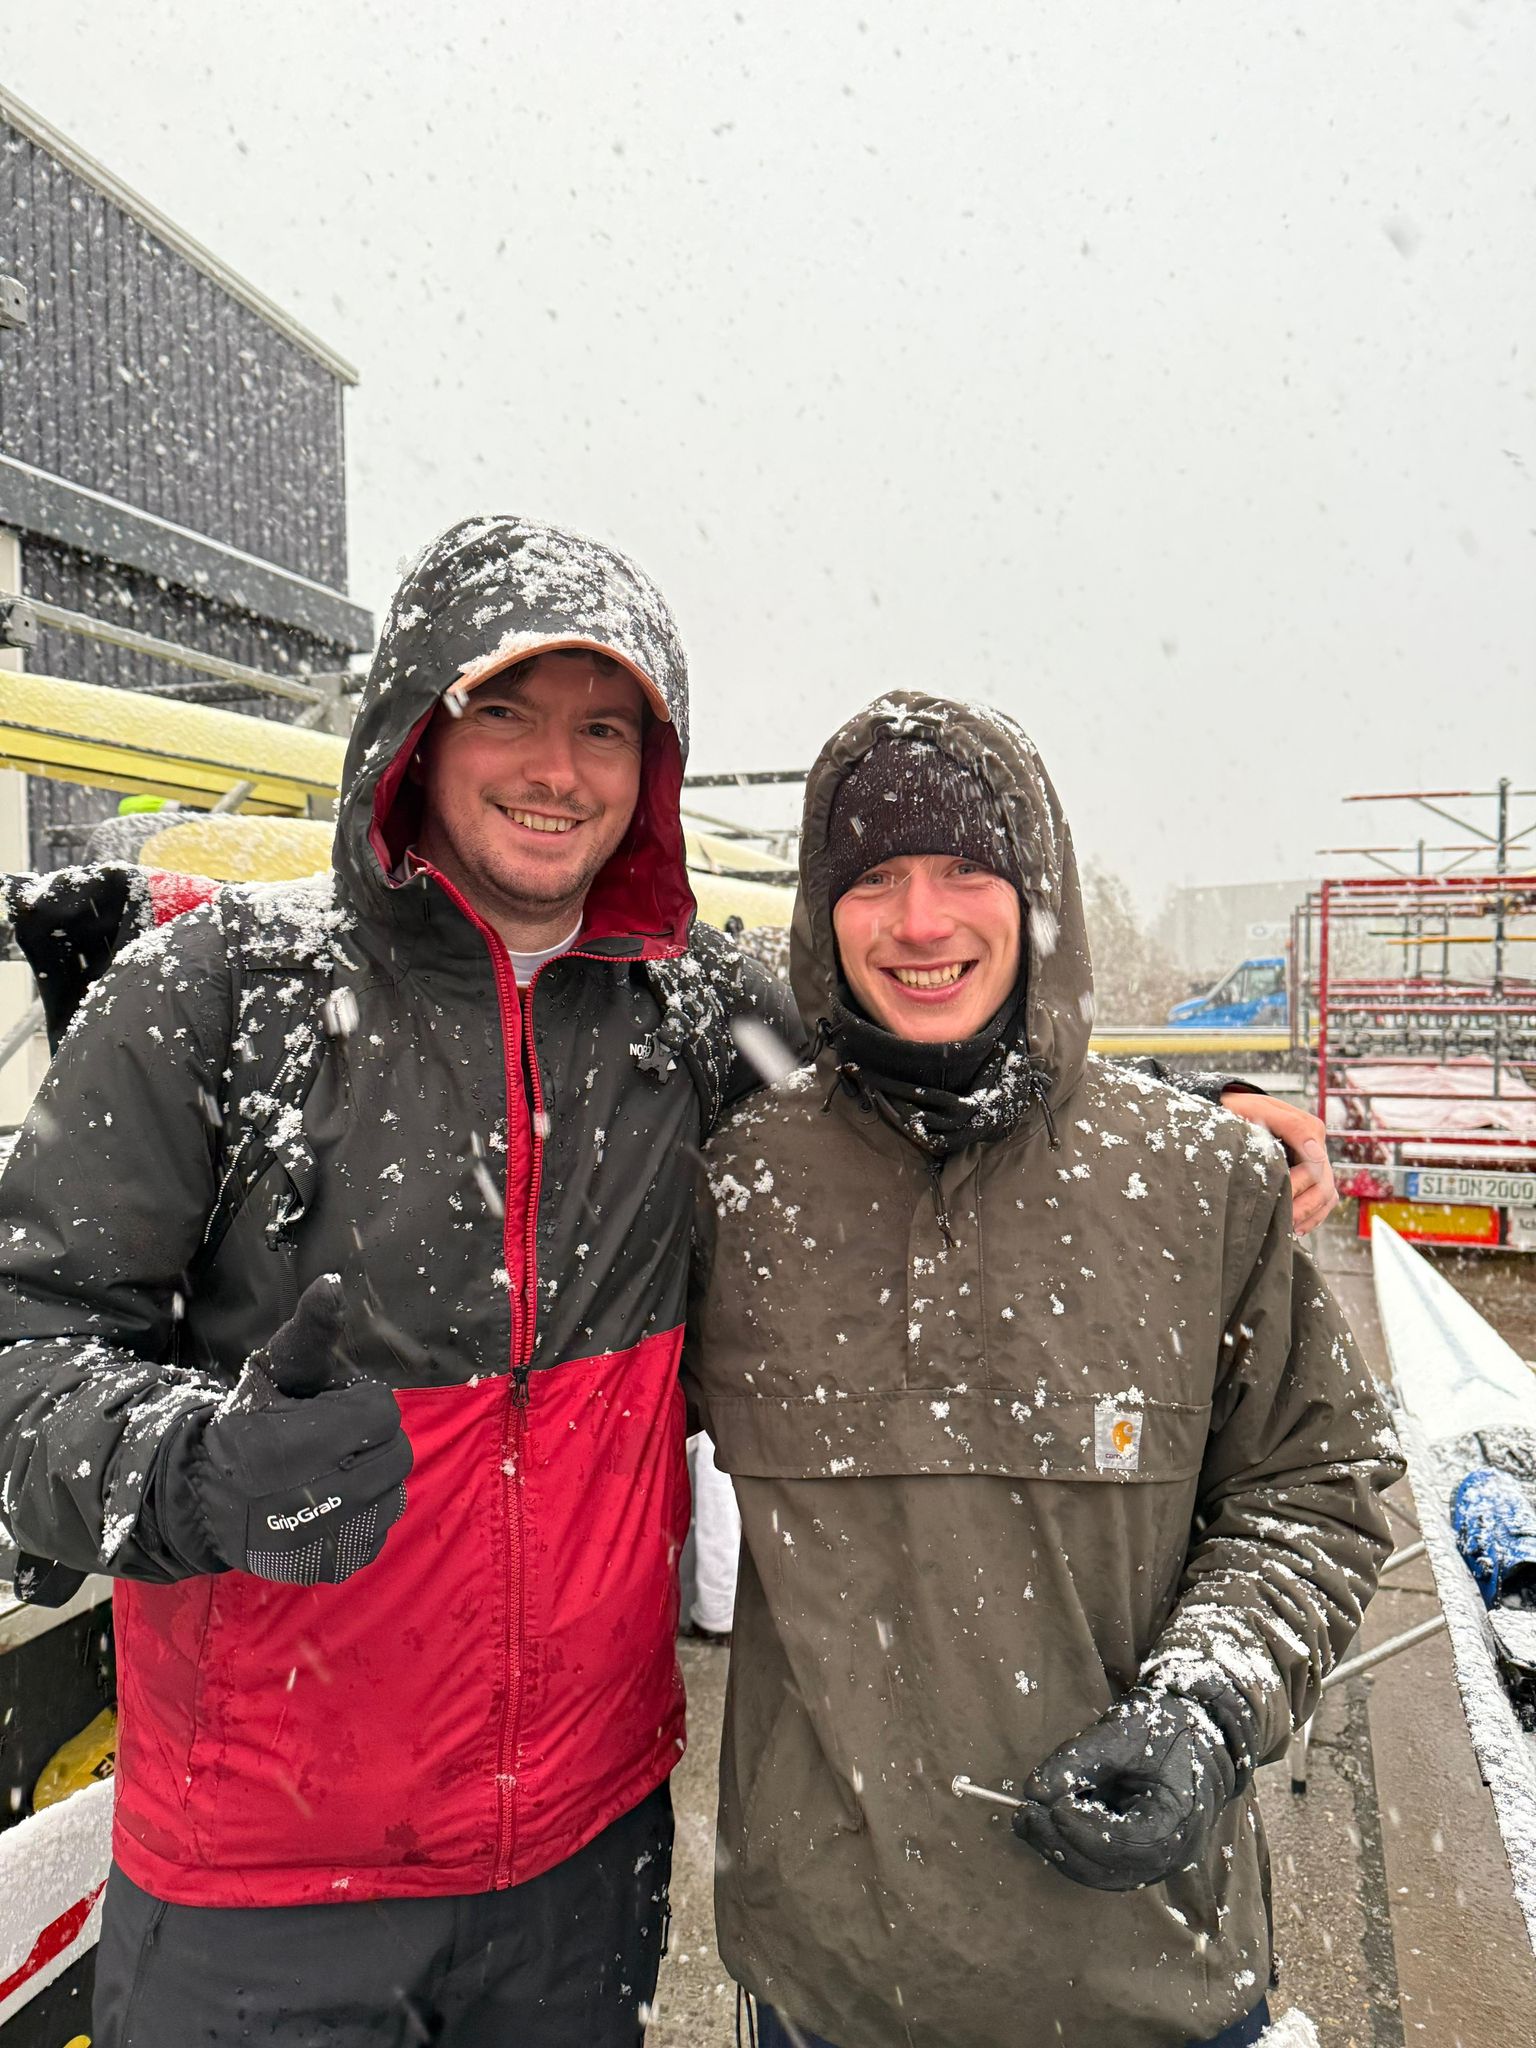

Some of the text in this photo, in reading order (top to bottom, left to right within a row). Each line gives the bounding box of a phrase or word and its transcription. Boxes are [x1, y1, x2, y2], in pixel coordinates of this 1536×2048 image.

[1422, 1176, 1443, 1195] SI
[1486, 1180, 1534, 1200] 2000
[266, 1496, 342, 1532] GripGrab
